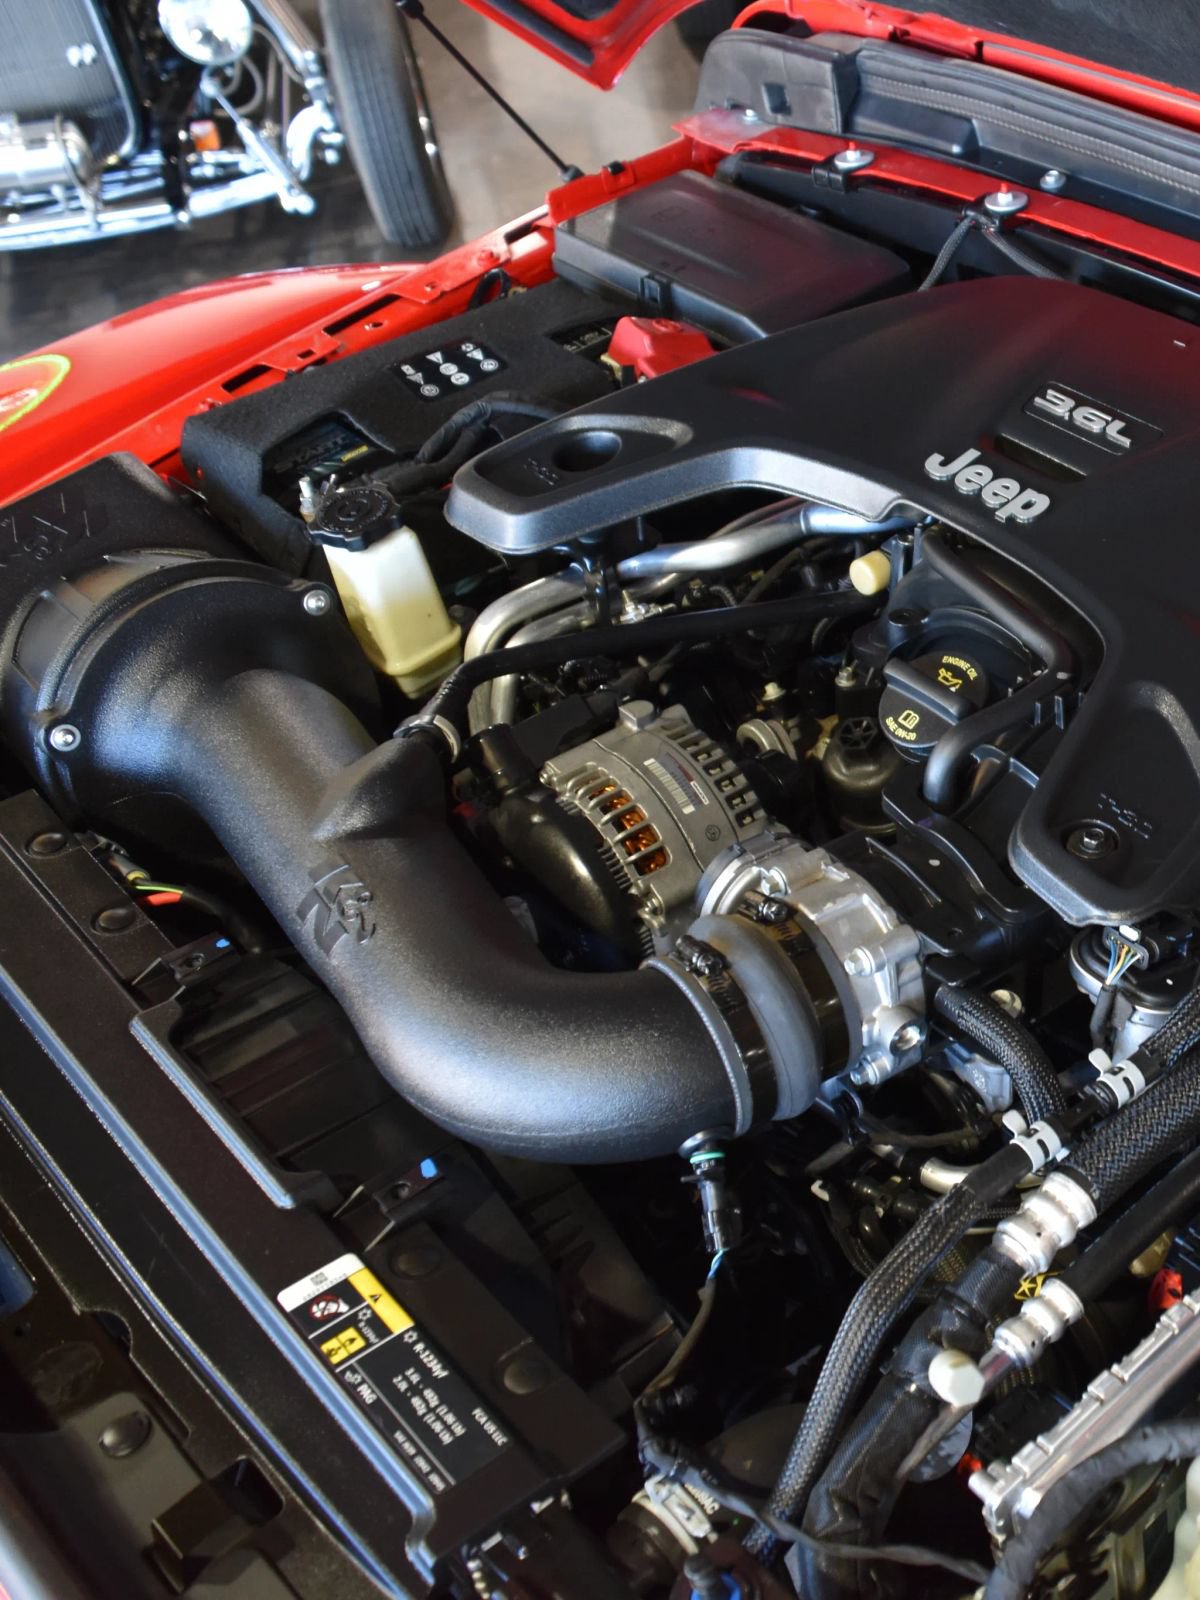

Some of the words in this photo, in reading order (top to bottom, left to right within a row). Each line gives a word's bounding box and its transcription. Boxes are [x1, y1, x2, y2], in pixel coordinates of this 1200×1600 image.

[1033, 388, 1132, 448] 3.6L
[924, 448, 1051, 524] Jeep
[942, 655, 971, 673] ENGINE
[967, 665, 978, 681] OIL
[885, 716, 898, 733] SAE
[895, 727, 917, 741] 0W-20
[405, 1367, 420, 1384] 3.6L
[413, 1342, 449, 1379] R-1234yf
[357, 1384, 376, 1404] PAG
[472, 1408, 487, 1423] FCA
[483, 1421, 496, 1434] US
[491, 1430, 507, 1446] LLC
